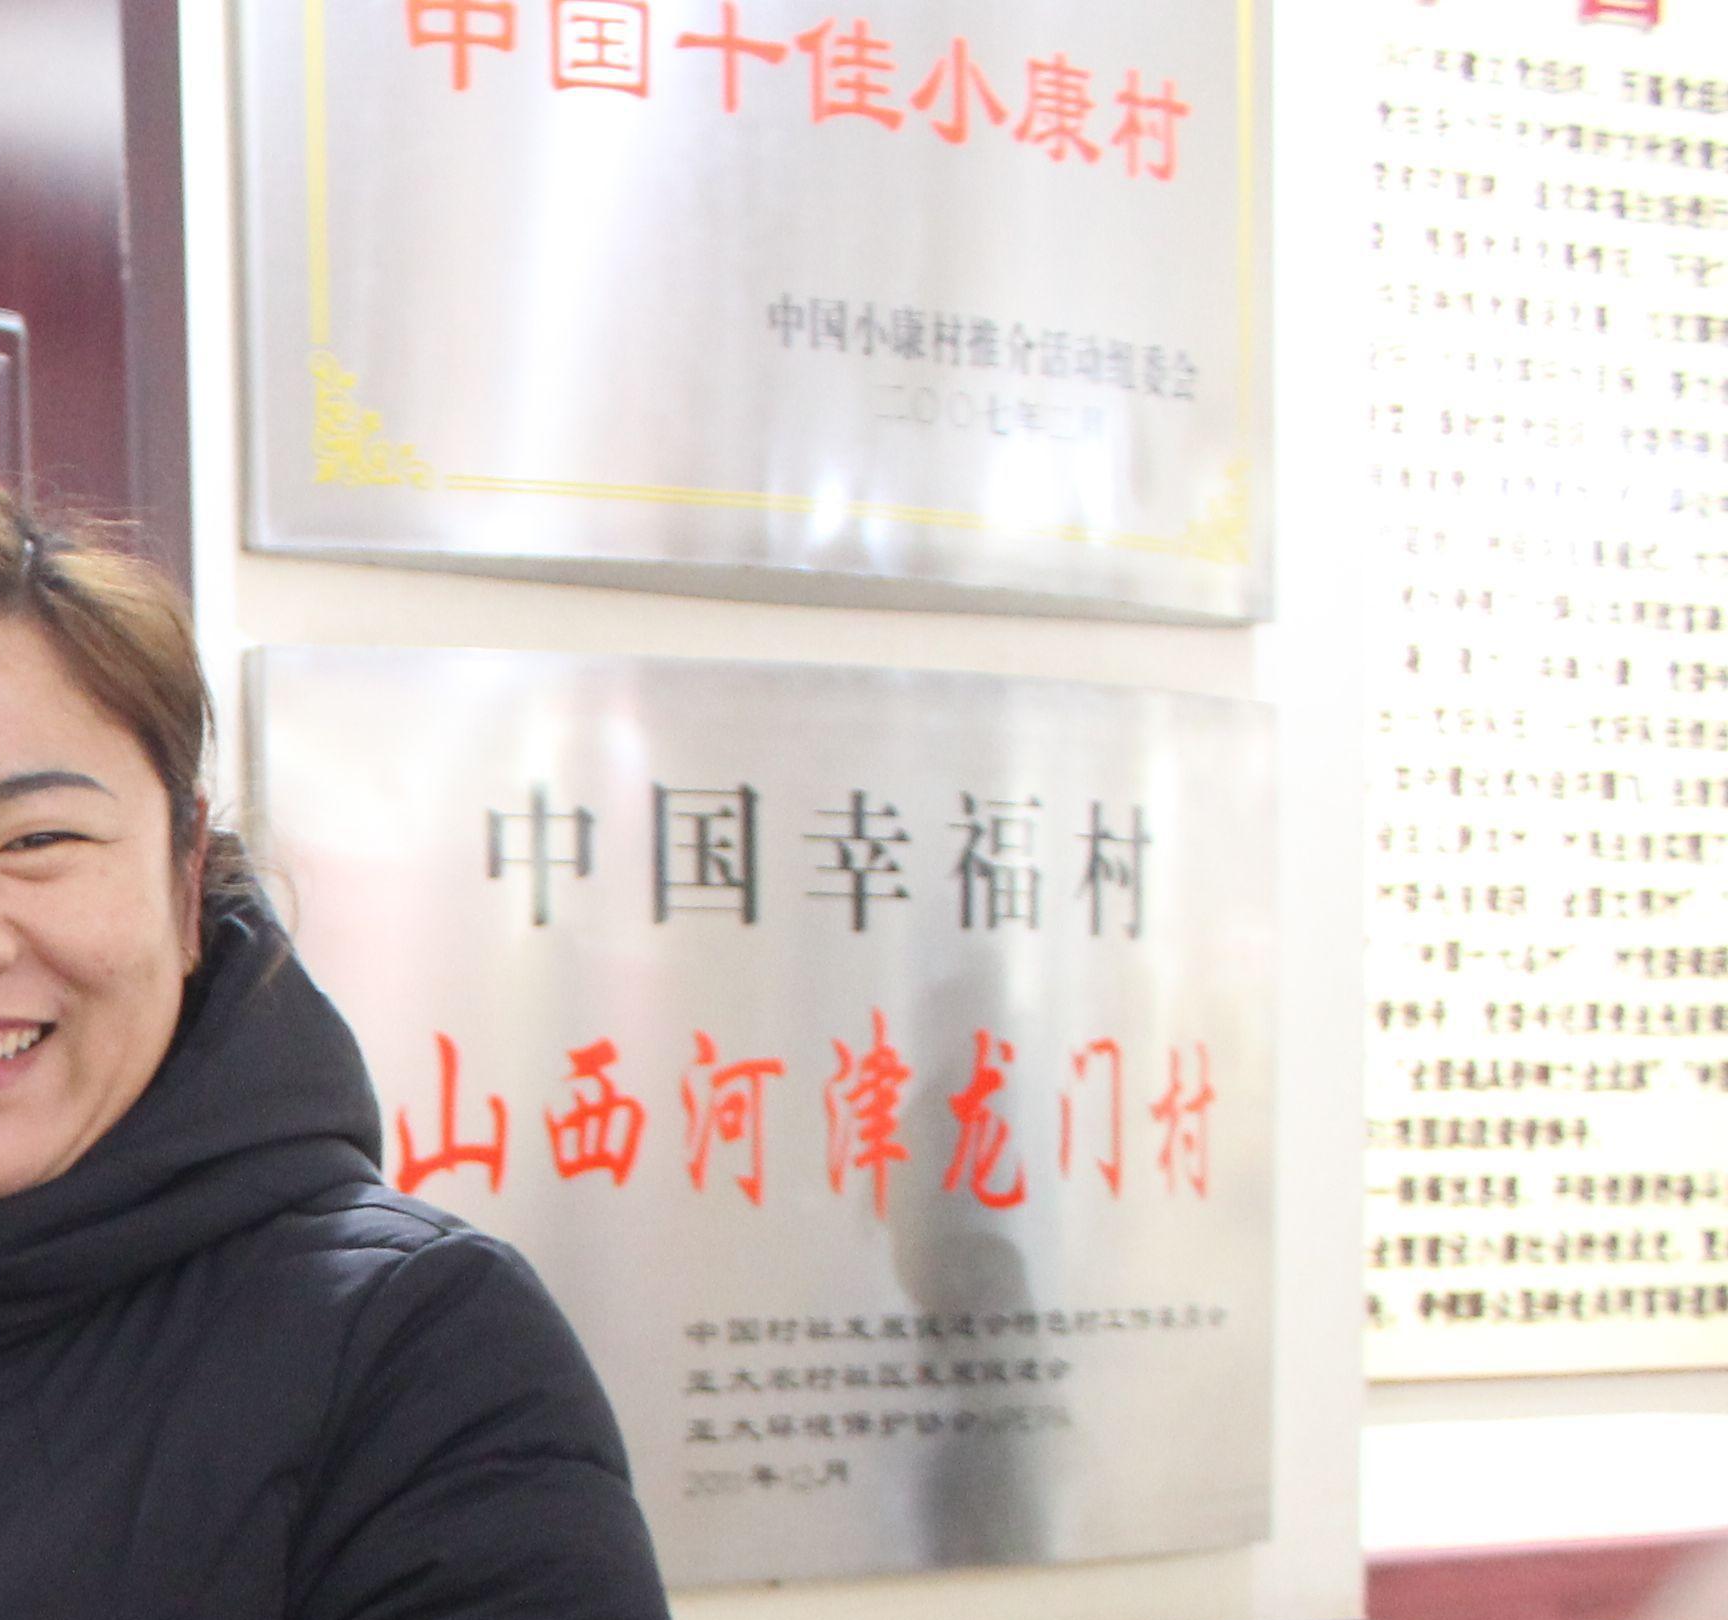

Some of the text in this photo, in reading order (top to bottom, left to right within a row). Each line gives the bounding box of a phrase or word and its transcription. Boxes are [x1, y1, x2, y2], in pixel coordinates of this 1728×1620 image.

[405, 0, 1192, 182] 中国十佳小康村
[485, 782, 1154, 940] 中国幸福村
[396, 1007, 1218, 1222] 山西河津龙门村
